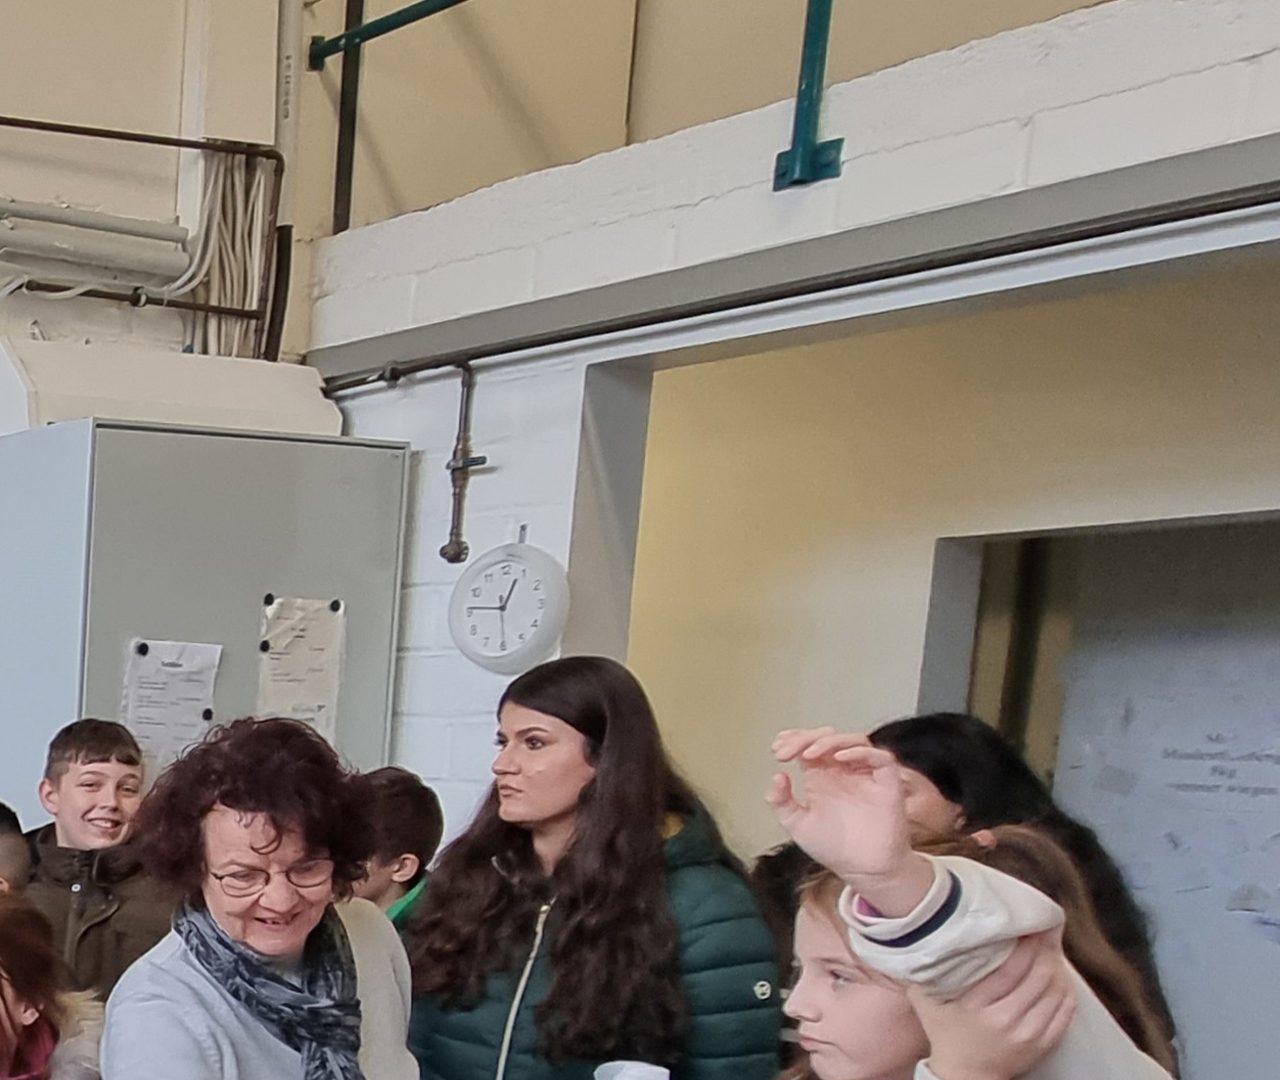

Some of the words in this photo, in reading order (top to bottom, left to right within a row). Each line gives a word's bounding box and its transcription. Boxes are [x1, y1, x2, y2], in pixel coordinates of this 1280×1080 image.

[500, 564, 511, 575] 12
[522, 569, 526, 577] 1
[484, 573, 494, 583] 11
[533, 579, 541, 591] 2
[471, 587, 481, 597] 10
[538, 599, 544, 609] 3
[531, 619, 538, 627] 4
[471, 625, 477, 635] 8
[483, 637, 490, 647] 7
[518, 633, 525, 643] 5
[500, 641, 506, 651] 6
